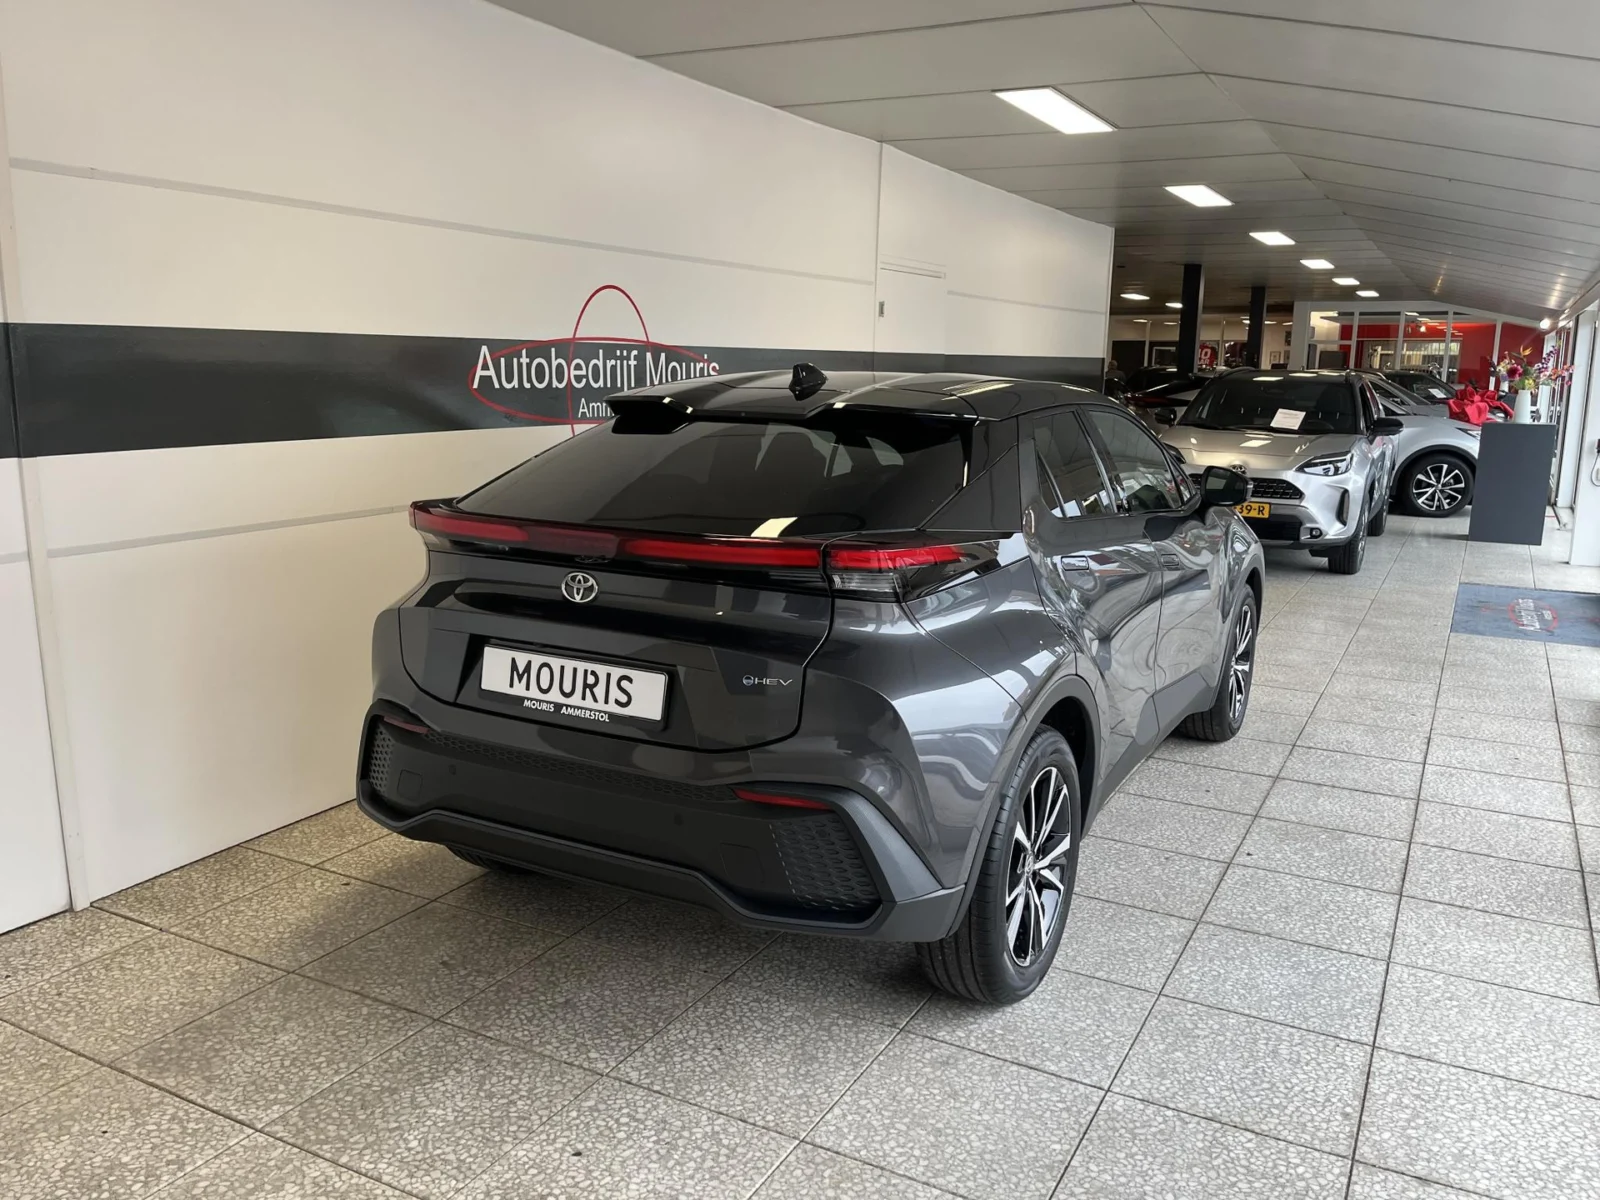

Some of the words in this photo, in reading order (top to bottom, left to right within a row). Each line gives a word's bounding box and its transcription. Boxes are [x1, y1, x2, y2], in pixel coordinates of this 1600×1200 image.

[472, 345, 639, 391] Autobedrijf
[646, 352, 719, 386] Mouris
[508, 657, 633, 709] MOURIS
[523, 699, 554, 712] MOURIS
[561, 706, 610, 722] AMMERSTOL
